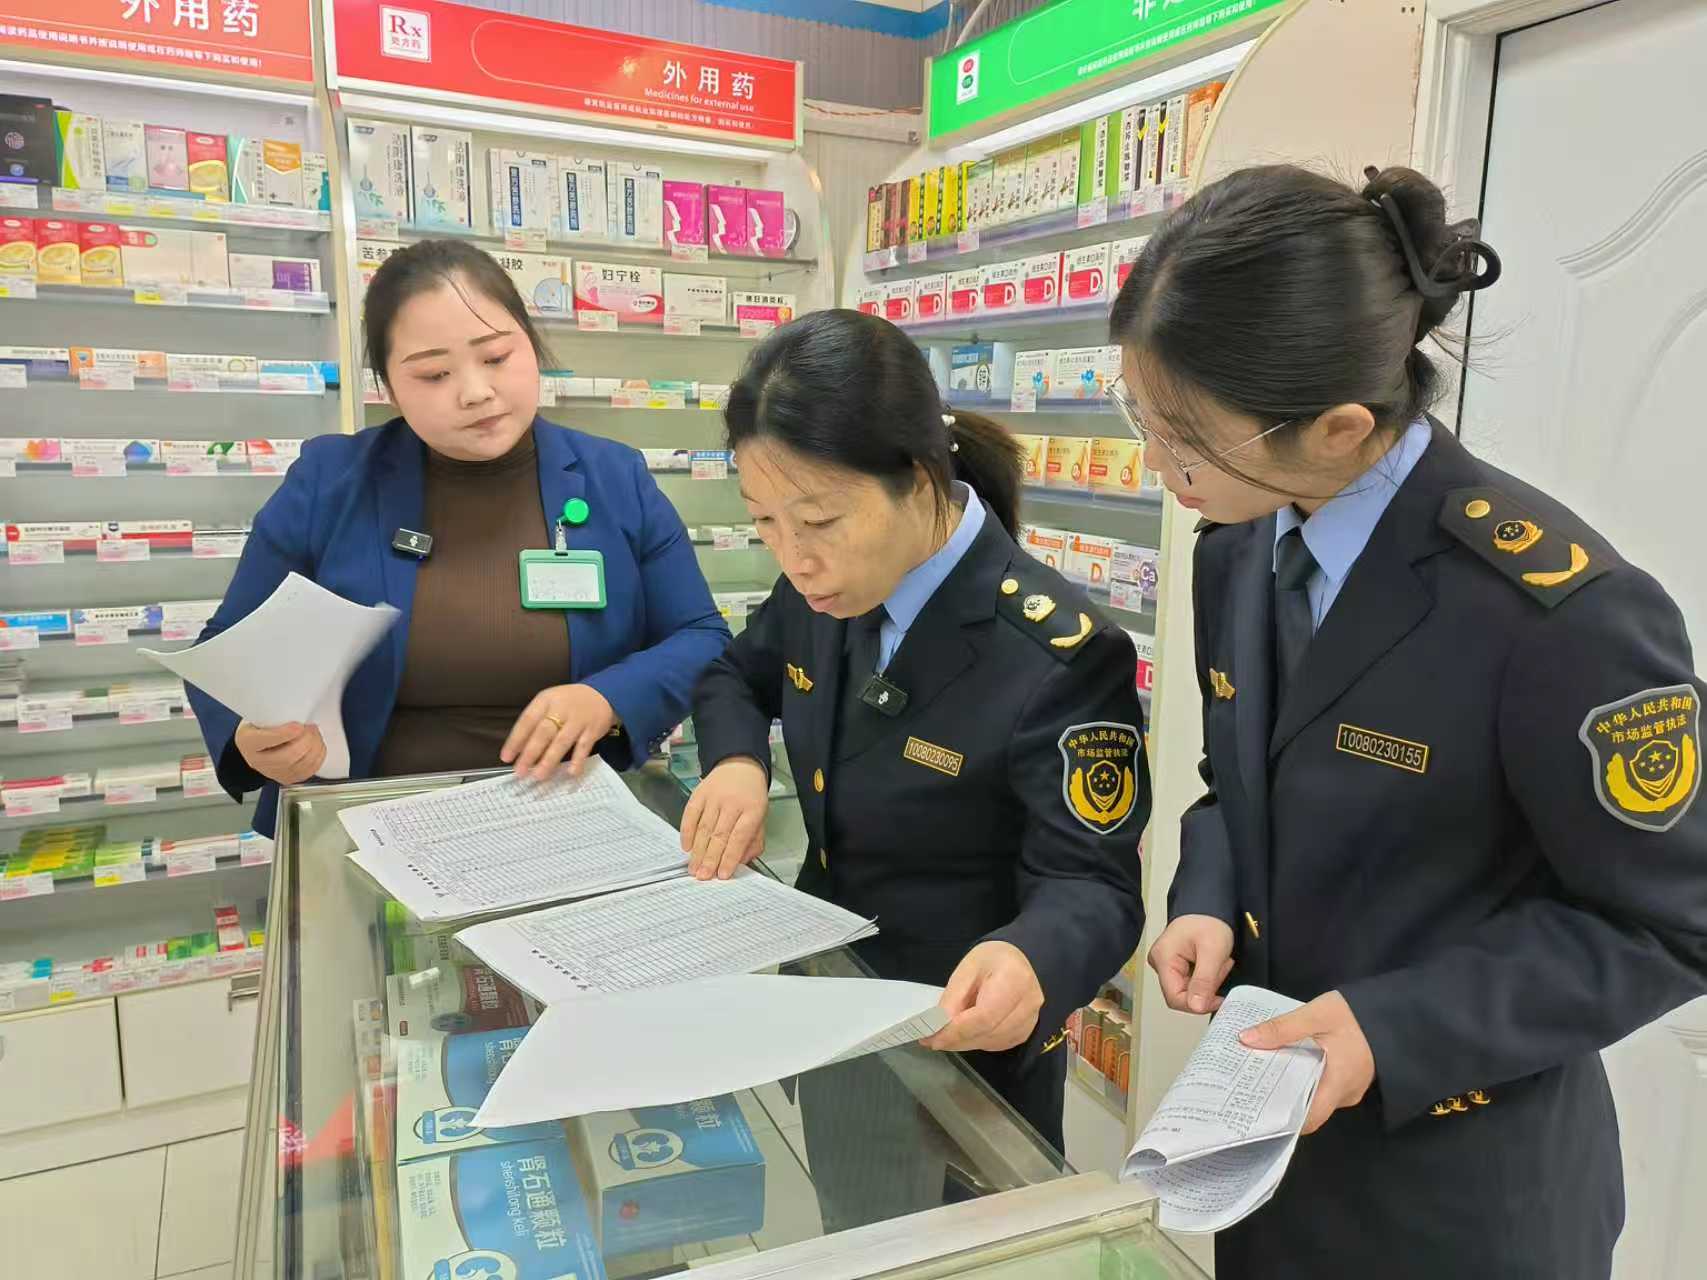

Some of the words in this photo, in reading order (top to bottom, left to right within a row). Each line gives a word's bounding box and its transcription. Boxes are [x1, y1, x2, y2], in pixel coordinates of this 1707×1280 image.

[390, 15, 422, 38] Rx
[391, 36, 422, 49] 处方药
[662, 60, 755, 100] 外用药
[644, 88, 689, 103] Medicines
[689, 94, 702, 105] for
[703, 98, 738, 110] external
[739, 102, 754, 113] use
[602, 267, 640, 283] 妇宁栓
[1141, 565, 1156, 583] Ca
[1596, 696, 1693, 734] 中华人民共和国
[1068, 730, 1136, 749] 中华人民共和国
[1612, 714, 1688, 744] 市场监管执法
[1077, 748, 1129, 758] 市场监管执法
[1342, 729, 1422, 766] 10080230155
[517, 1155, 567, 1251] 肾石通颗粒
